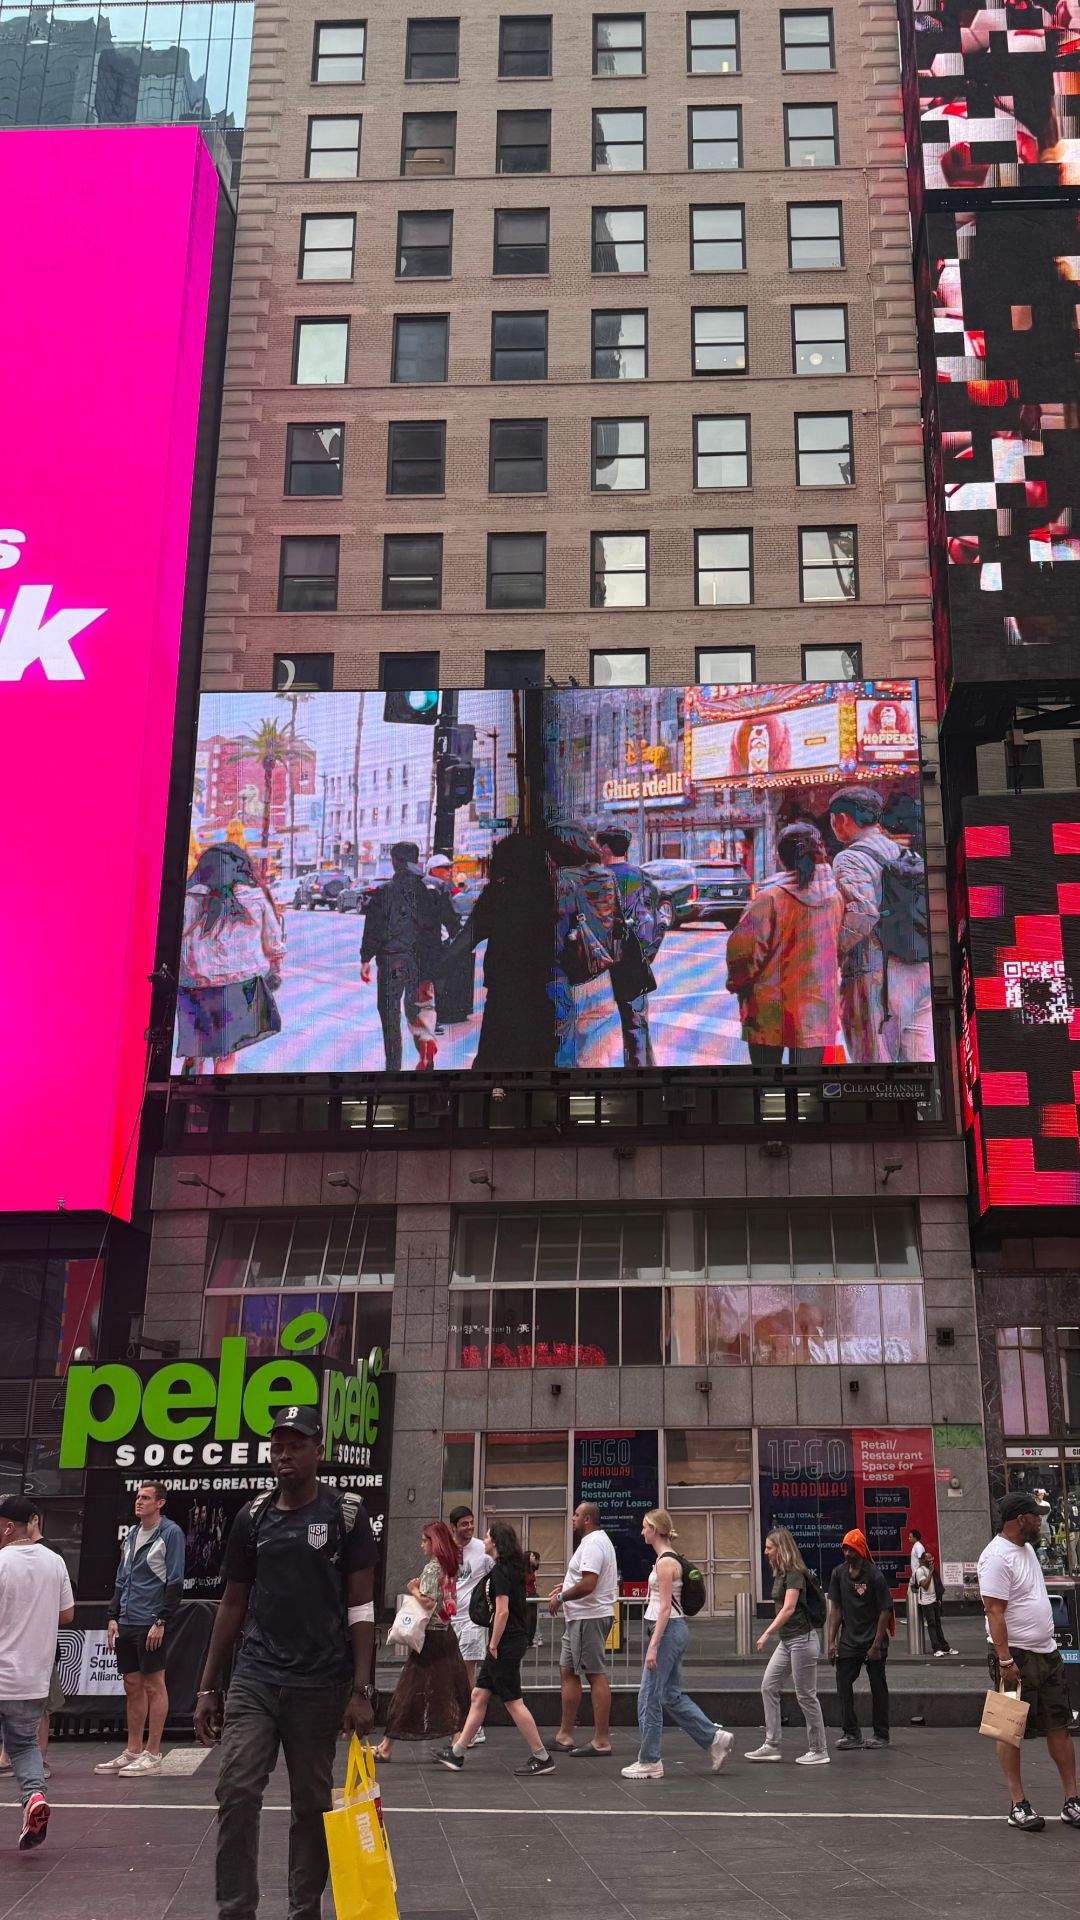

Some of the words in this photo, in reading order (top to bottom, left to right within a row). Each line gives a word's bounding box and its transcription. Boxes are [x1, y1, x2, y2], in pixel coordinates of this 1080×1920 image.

[0, 584, 109, 681] k
[863, 733, 915, 745] HOPPERS
[286, 1406, 299, 1420] B
[861, 1440, 897, 1451] Retail/
[115, 1442, 272, 1467] SOCCER
[337, 1444, 371, 1466] SOCCER
[580, 1438, 631, 1466] 1560
[861, 1451, 923, 1460] Restaurant
[767, 1439, 847, 1480] 1560
[582, 1467, 631, 1477] BROADWAY
[862, 1461, 896, 1472] Space
[898, 1461, 914, 1470] for
[863, 1472, 895, 1481] Lease
[125, 1479, 145, 1491] TH
[339, 1474, 383, 1488] STORE
[581, 1480, 612, 1490] Retail/
[581, 1490, 632, 1499] Restaurant
[772, 1482, 848, 1497] BROADWAY
[611, 1499, 624, 1508] for
[626, 1500, 653, 1508] Lease
[310, 1526, 327, 1535] USA
[1060, 1653, 1078, 1661] ARE
[90, 1656, 119, 1670] Squa
[90, 1671, 123, 1682] Allianc
